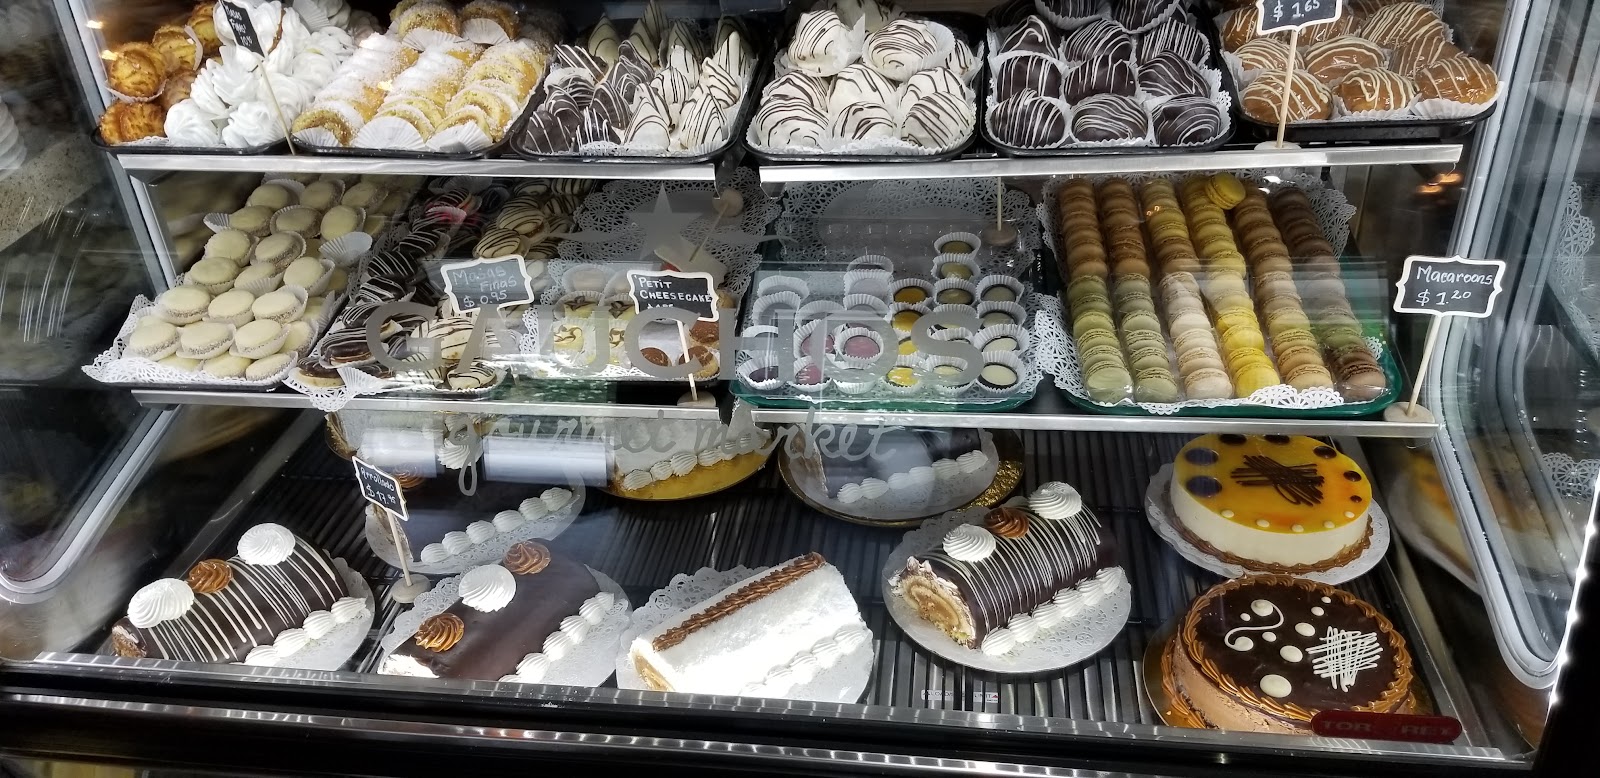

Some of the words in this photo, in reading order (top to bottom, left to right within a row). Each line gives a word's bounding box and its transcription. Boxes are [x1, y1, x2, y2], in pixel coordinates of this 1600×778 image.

[1273, 0, 1284, 23] $
[1291, 0, 1321, 18] 1.65
[452, 266, 507, 285] Masas
[480, 275, 517, 292] Finas
[1416, 265, 1493, 285] Macaroons
[463, 294, 475, 308] $
[480, 289, 508, 305] 0.95
[639, 289, 713, 303] CHEESECAKE
[1415, 288, 1431, 307] $
[1435, 289, 1472, 306] 1.20
[365, 301, 985, 386] GAUCHOS
[449, 408, 678, 497] gourmet
[693, 405, 906, 462] market
[360, 466, 395, 492] Arrollado
[366, 483, 376, 498] $
